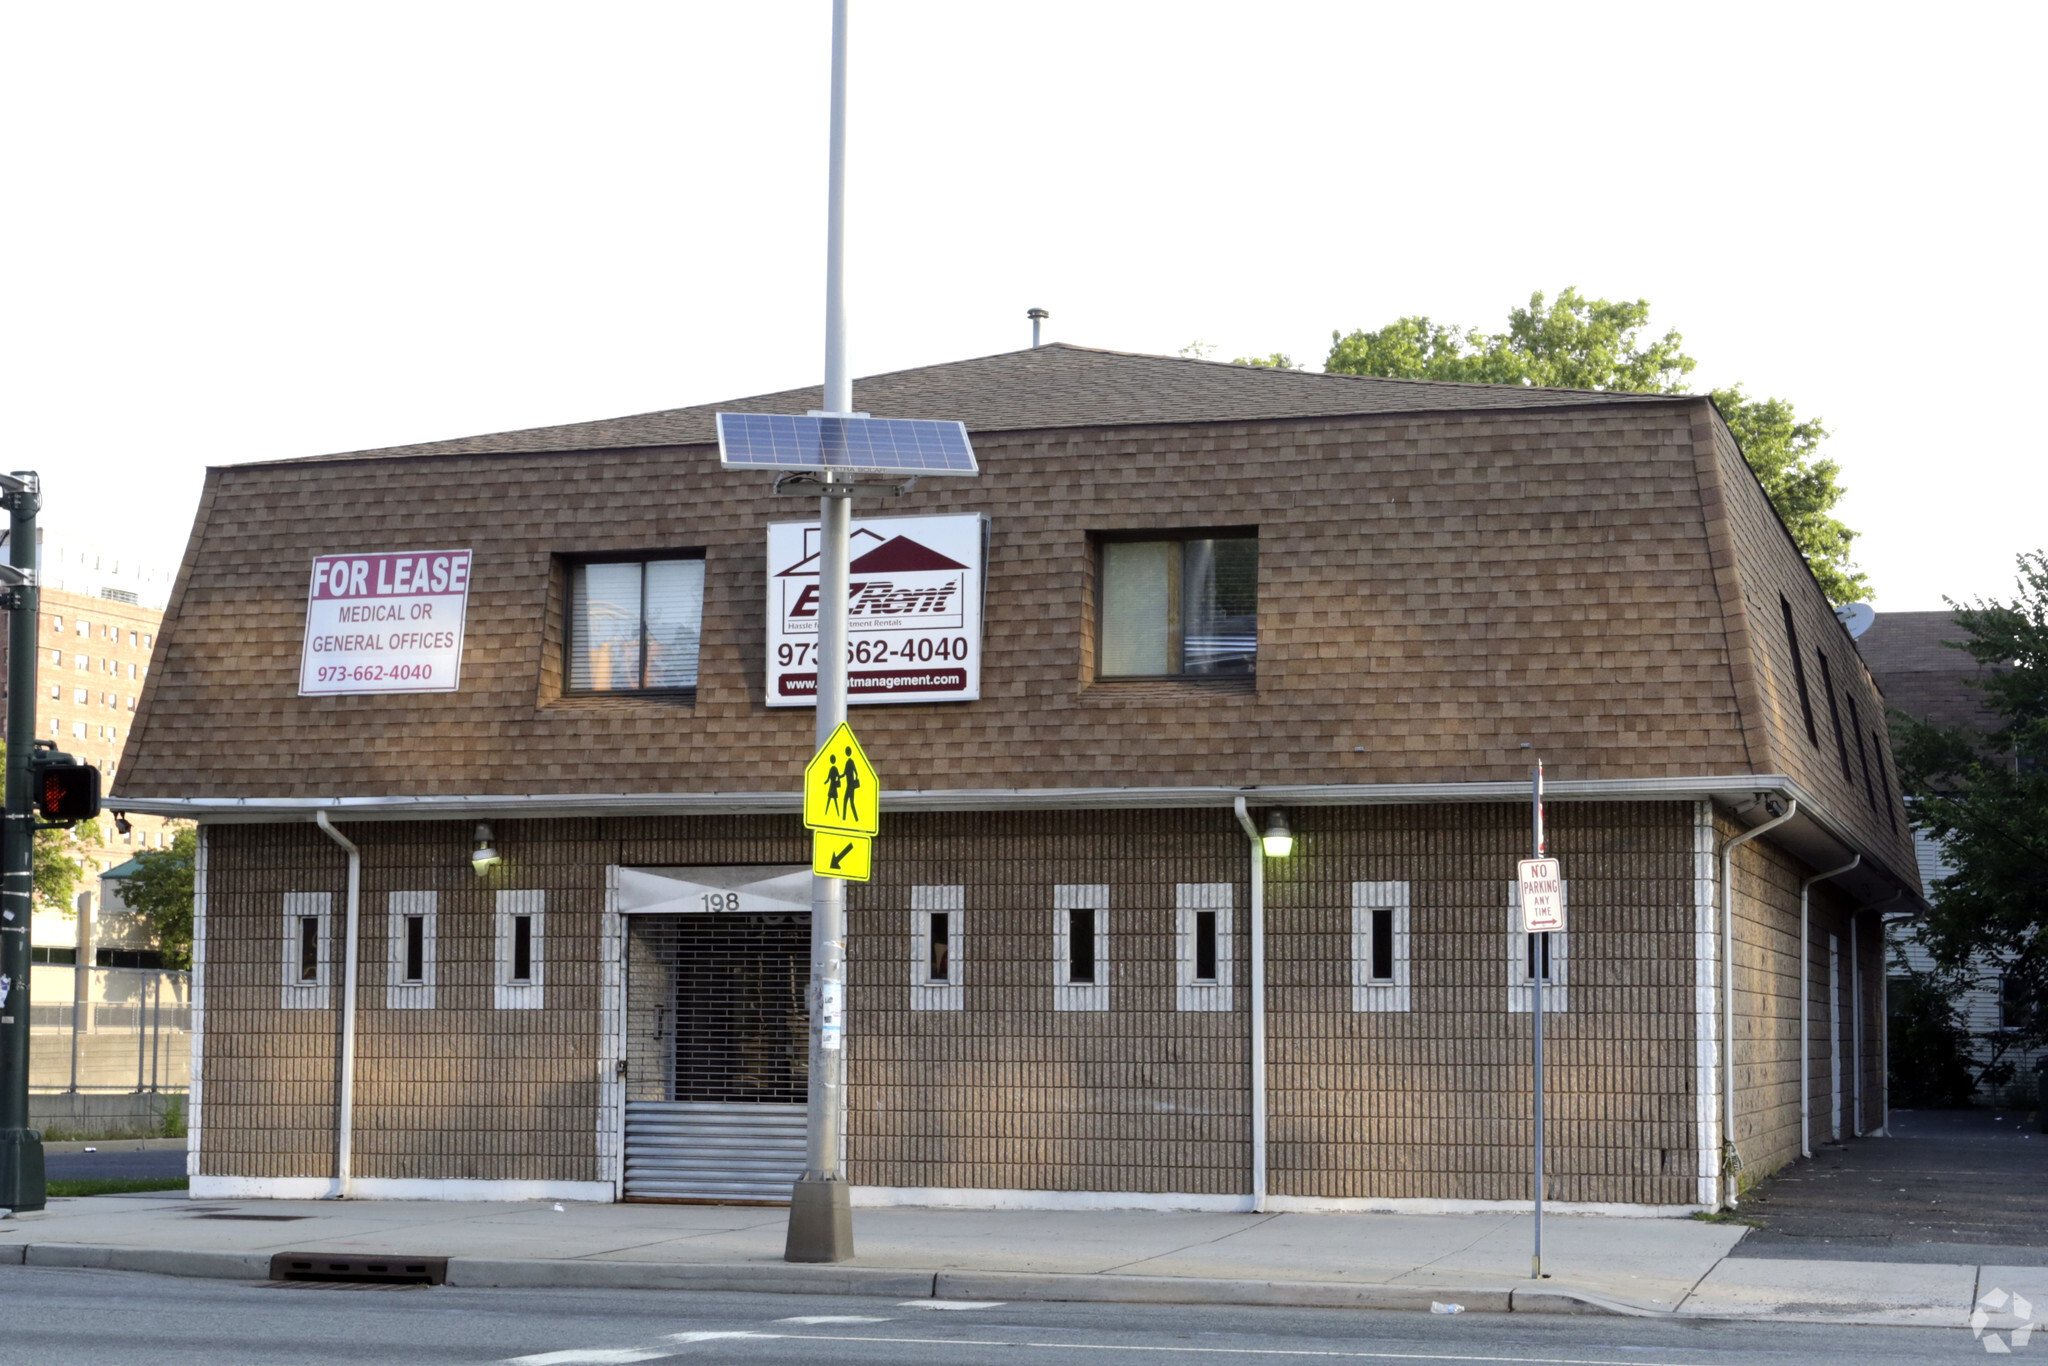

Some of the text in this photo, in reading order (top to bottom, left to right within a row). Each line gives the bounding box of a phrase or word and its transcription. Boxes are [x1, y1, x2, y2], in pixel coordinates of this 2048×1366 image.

[313, 556, 468, 597] FOR LEASE
[339, 603, 432, 623] MEDICAL OR
[788, 622, 813, 631] Hassle
[874, 619, 902, 627] Rentals
[312, 631, 454, 653] GENERAL OFFICES
[777, 637, 968, 666] 9762-4040
[317, 664, 433, 682] 973-662-4040
[786, 675, 960, 690] www.tmanagement.com
[1531, 864, 1548, 878] NO
[1524, 880, 1557, 894] PARKING
[701, 893, 739, 913] 198
[1535, 896, 1549, 906] ANY
[1535, 907, 1552, 917] TIME
